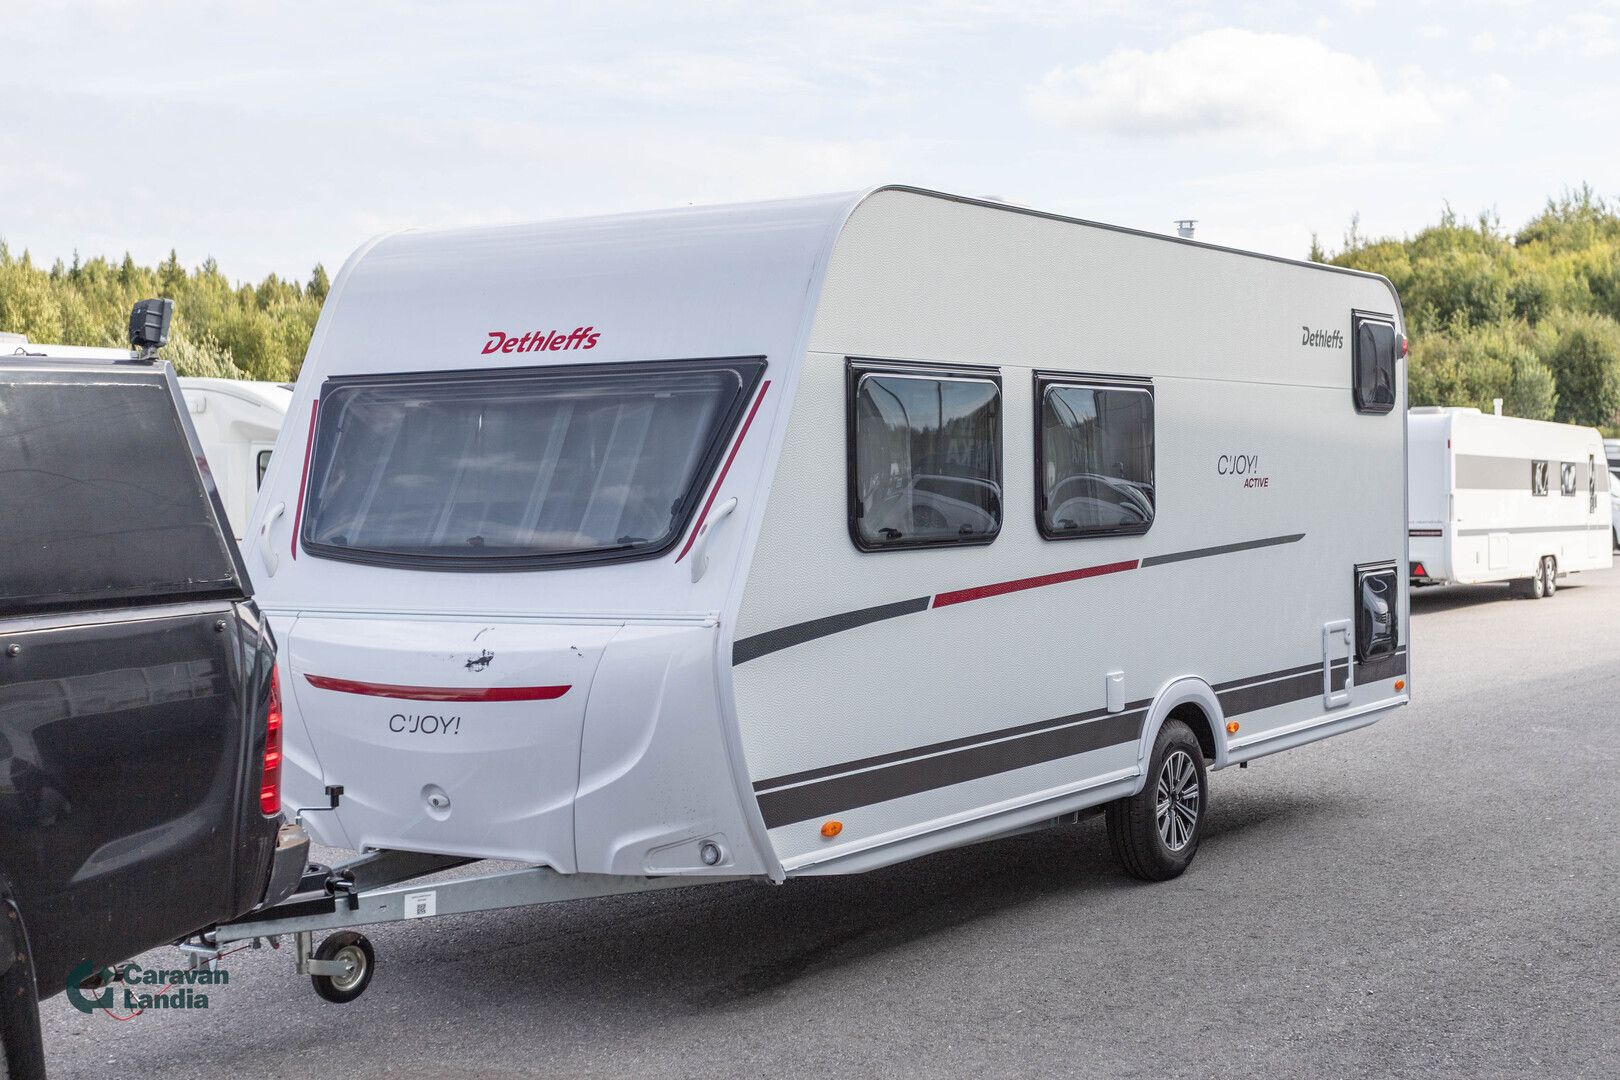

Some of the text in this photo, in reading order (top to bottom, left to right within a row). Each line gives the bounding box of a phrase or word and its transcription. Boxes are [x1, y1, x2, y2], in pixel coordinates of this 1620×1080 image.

[481, 326, 601, 355] Dethleffs
[1302, 325, 1344, 349] Dethleffs
[1217, 454, 1258, 475] C'JOY!
[1243, 477, 1269, 488] ACTIVE
[389, 713, 461, 735] C'JOY!
